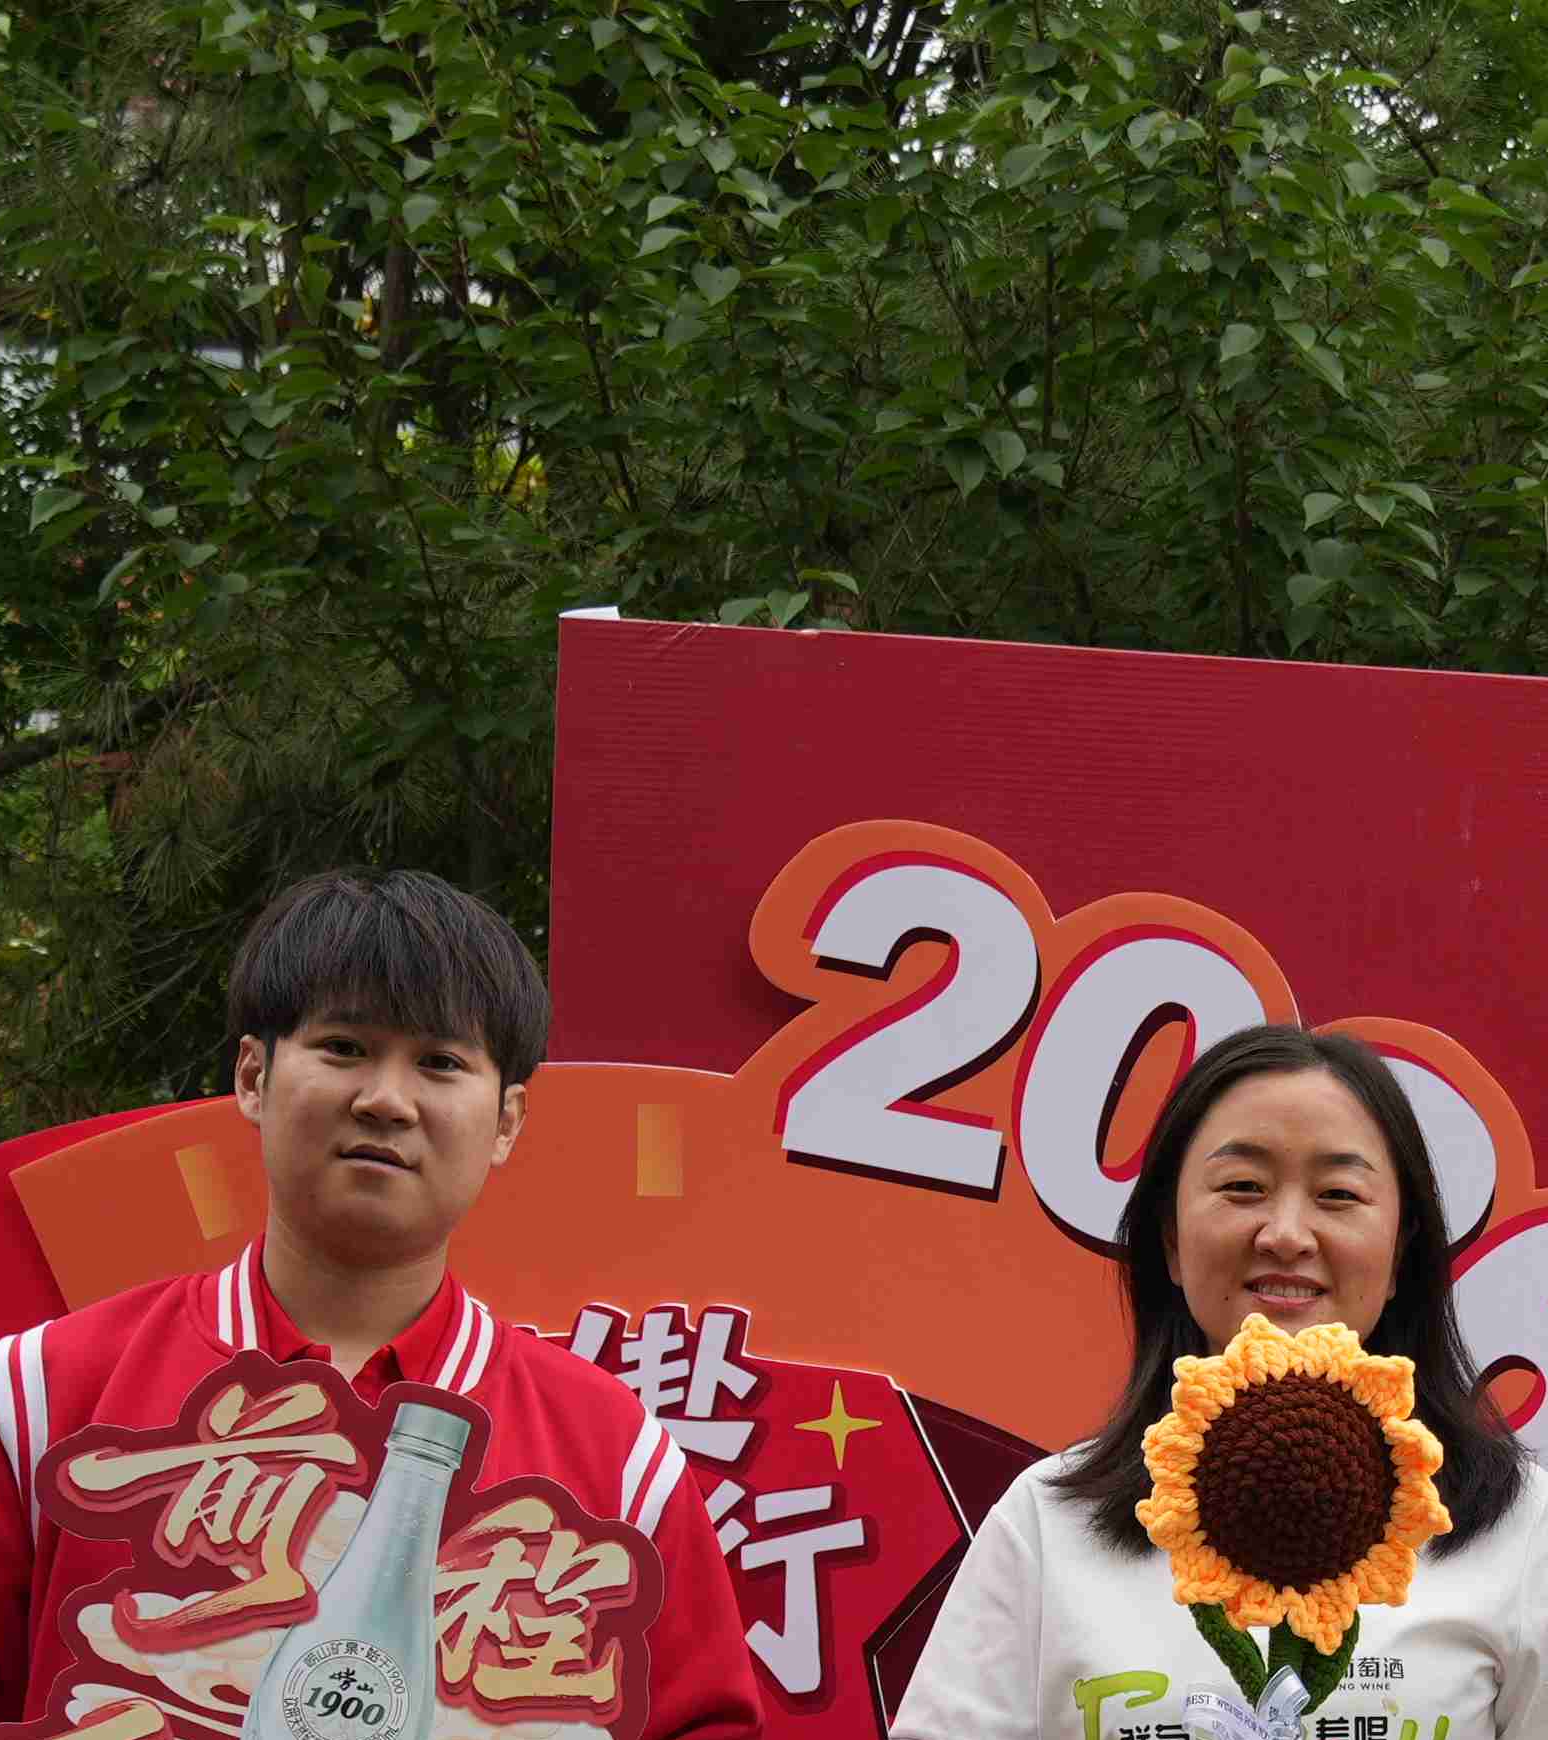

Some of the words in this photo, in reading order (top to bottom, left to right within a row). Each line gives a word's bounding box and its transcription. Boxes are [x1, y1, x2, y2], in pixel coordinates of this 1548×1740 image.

[570, 1310, 758, 1462] 赴
[304, 1686, 385, 1725] 1900
[1362, 1682, 1391, 1690] WINE
